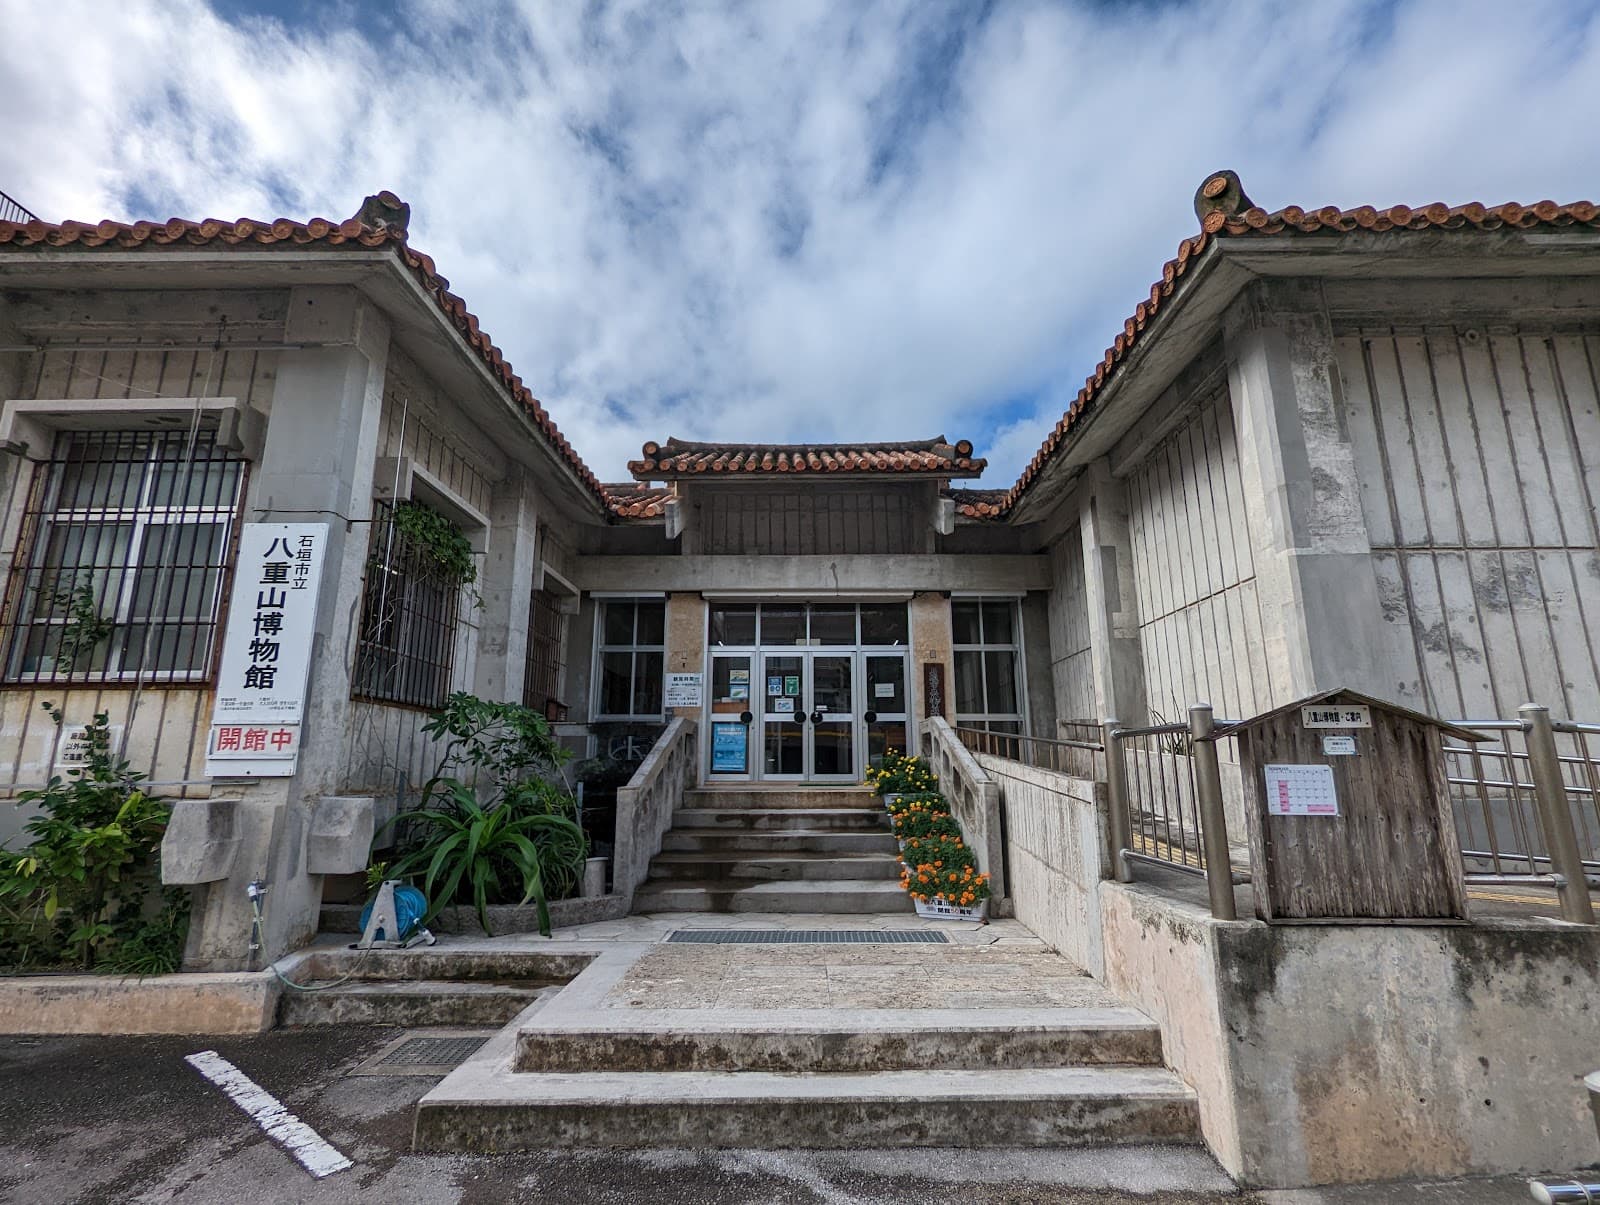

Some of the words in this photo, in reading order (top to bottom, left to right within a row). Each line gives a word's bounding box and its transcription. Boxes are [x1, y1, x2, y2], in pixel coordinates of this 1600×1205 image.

[291, 535, 315, 590] 石垣市立
[243, 537, 294, 690] 八重山博物館
[216, 727, 293, 752] 開館中
